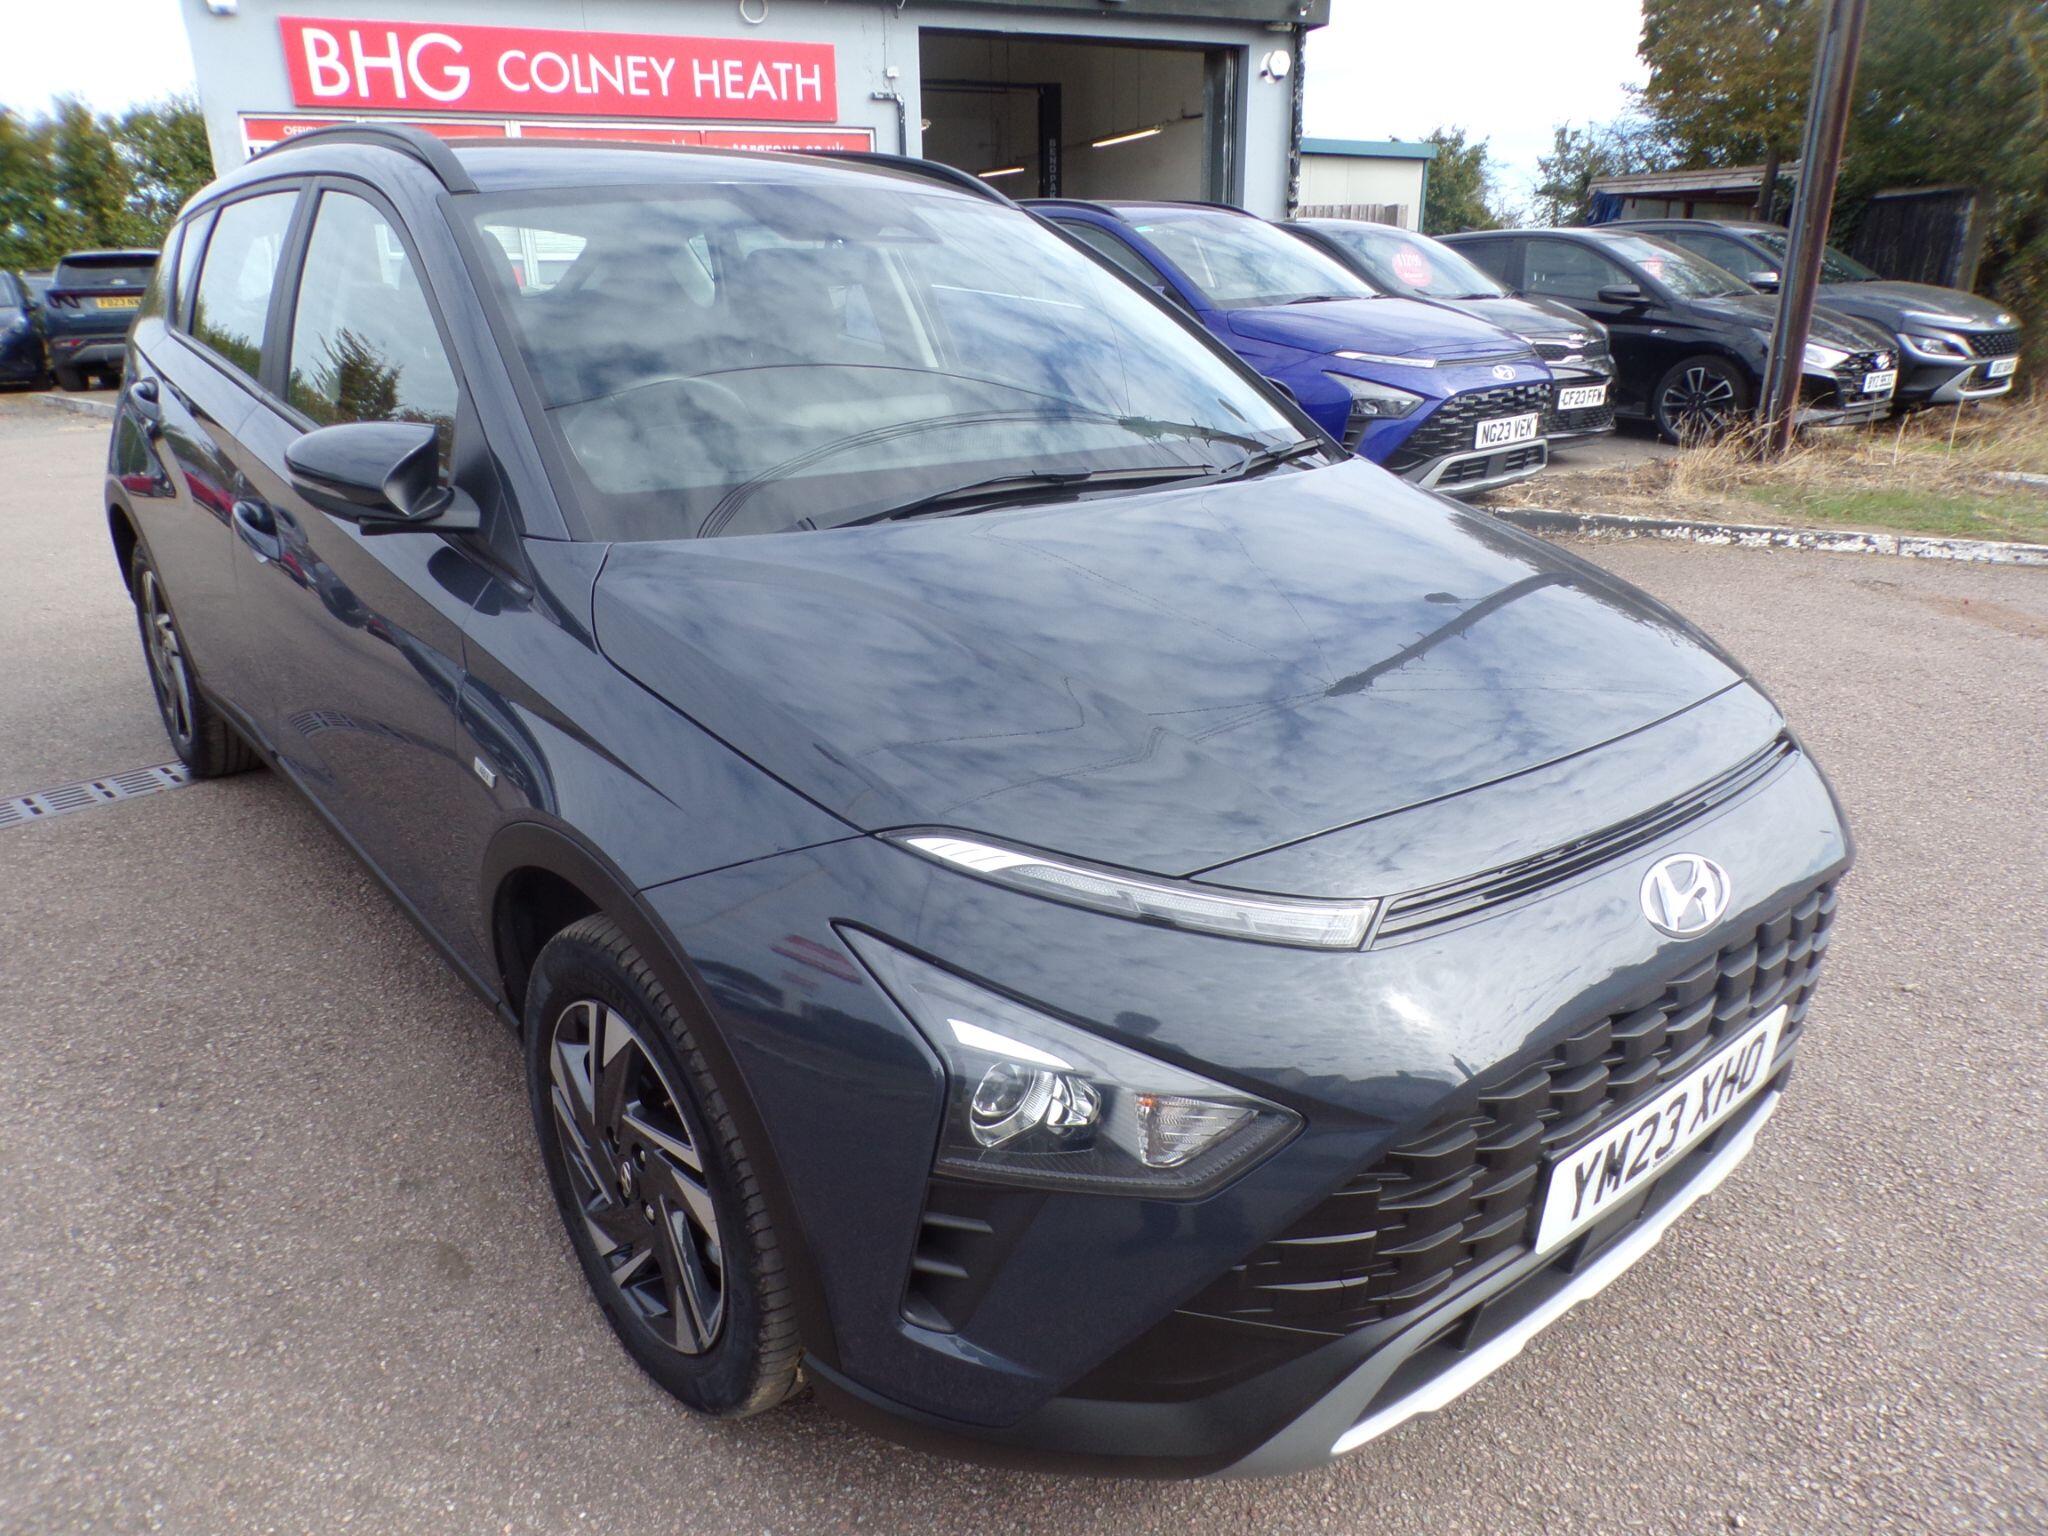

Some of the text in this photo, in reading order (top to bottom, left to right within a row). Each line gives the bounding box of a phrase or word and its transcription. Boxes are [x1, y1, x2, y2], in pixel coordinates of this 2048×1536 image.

[302, 27, 822, 102] BHG COLNEY HEATH
[1481, 417, 1534, 444] NG23 VEK
[1571, 1031, 1768, 1222] YM23 XHO
